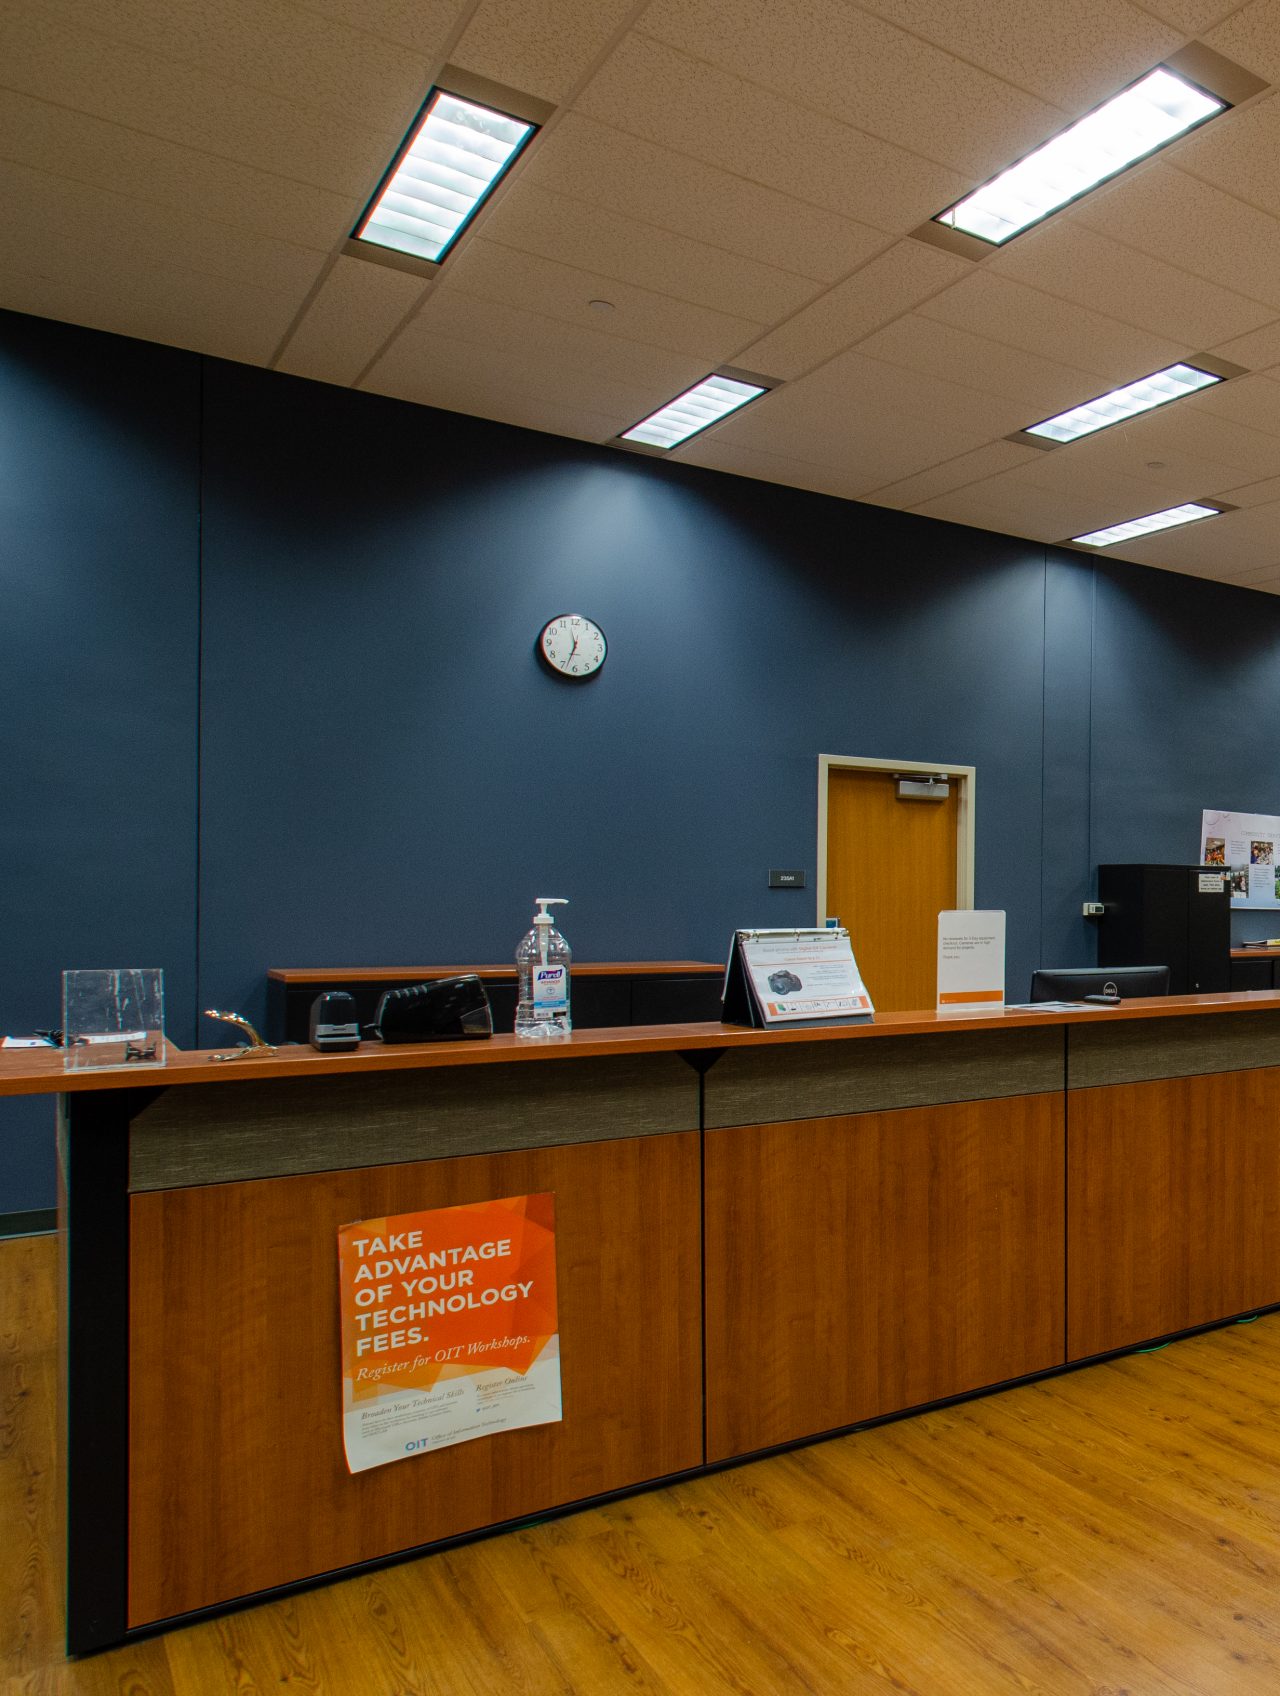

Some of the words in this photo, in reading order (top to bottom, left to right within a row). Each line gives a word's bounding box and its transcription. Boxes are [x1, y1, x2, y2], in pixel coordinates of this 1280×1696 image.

[559, 620, 566, 628] 11
[570, 618, 580, 626] 12
[585, 623, 589, 631] 1
[593, 632, 599, 640] 2
[550, 650, 556, 658] 8
[597, 643, 603, 652] 3
[560, 660, 566, 669] 7
[584, 662, 590, 671] 5
[352, 1230, 423, 1258] TAKE
[354, 1239, 511, 1283] ADVANTAGE
[355, 1284, 393, 1307] OF
[401, 1269, 474, 1297] YOUR
[355, 1281, 534, 1331] TECHNOLOGY
[356, 1327, 429, 1357] FEES.
[356, 1359, 409, 1381] Register
[409, 1355, 432, 1374] for
[434, 1345, 465, 1362] OIT
[467, 1335, 531, 1356] Workshops.
[476, 1380, 502, 1392] Register
[504, 1375, 528, 1385] Online
[361, 1407, 392, 1420] Broaden
[393, 1402, 410, 1412] Your
[411, 1393, 445, 1408] Technical
[446, 1388, 465, 1400] Skills
[405, 1437, 429, 1452] OIT
